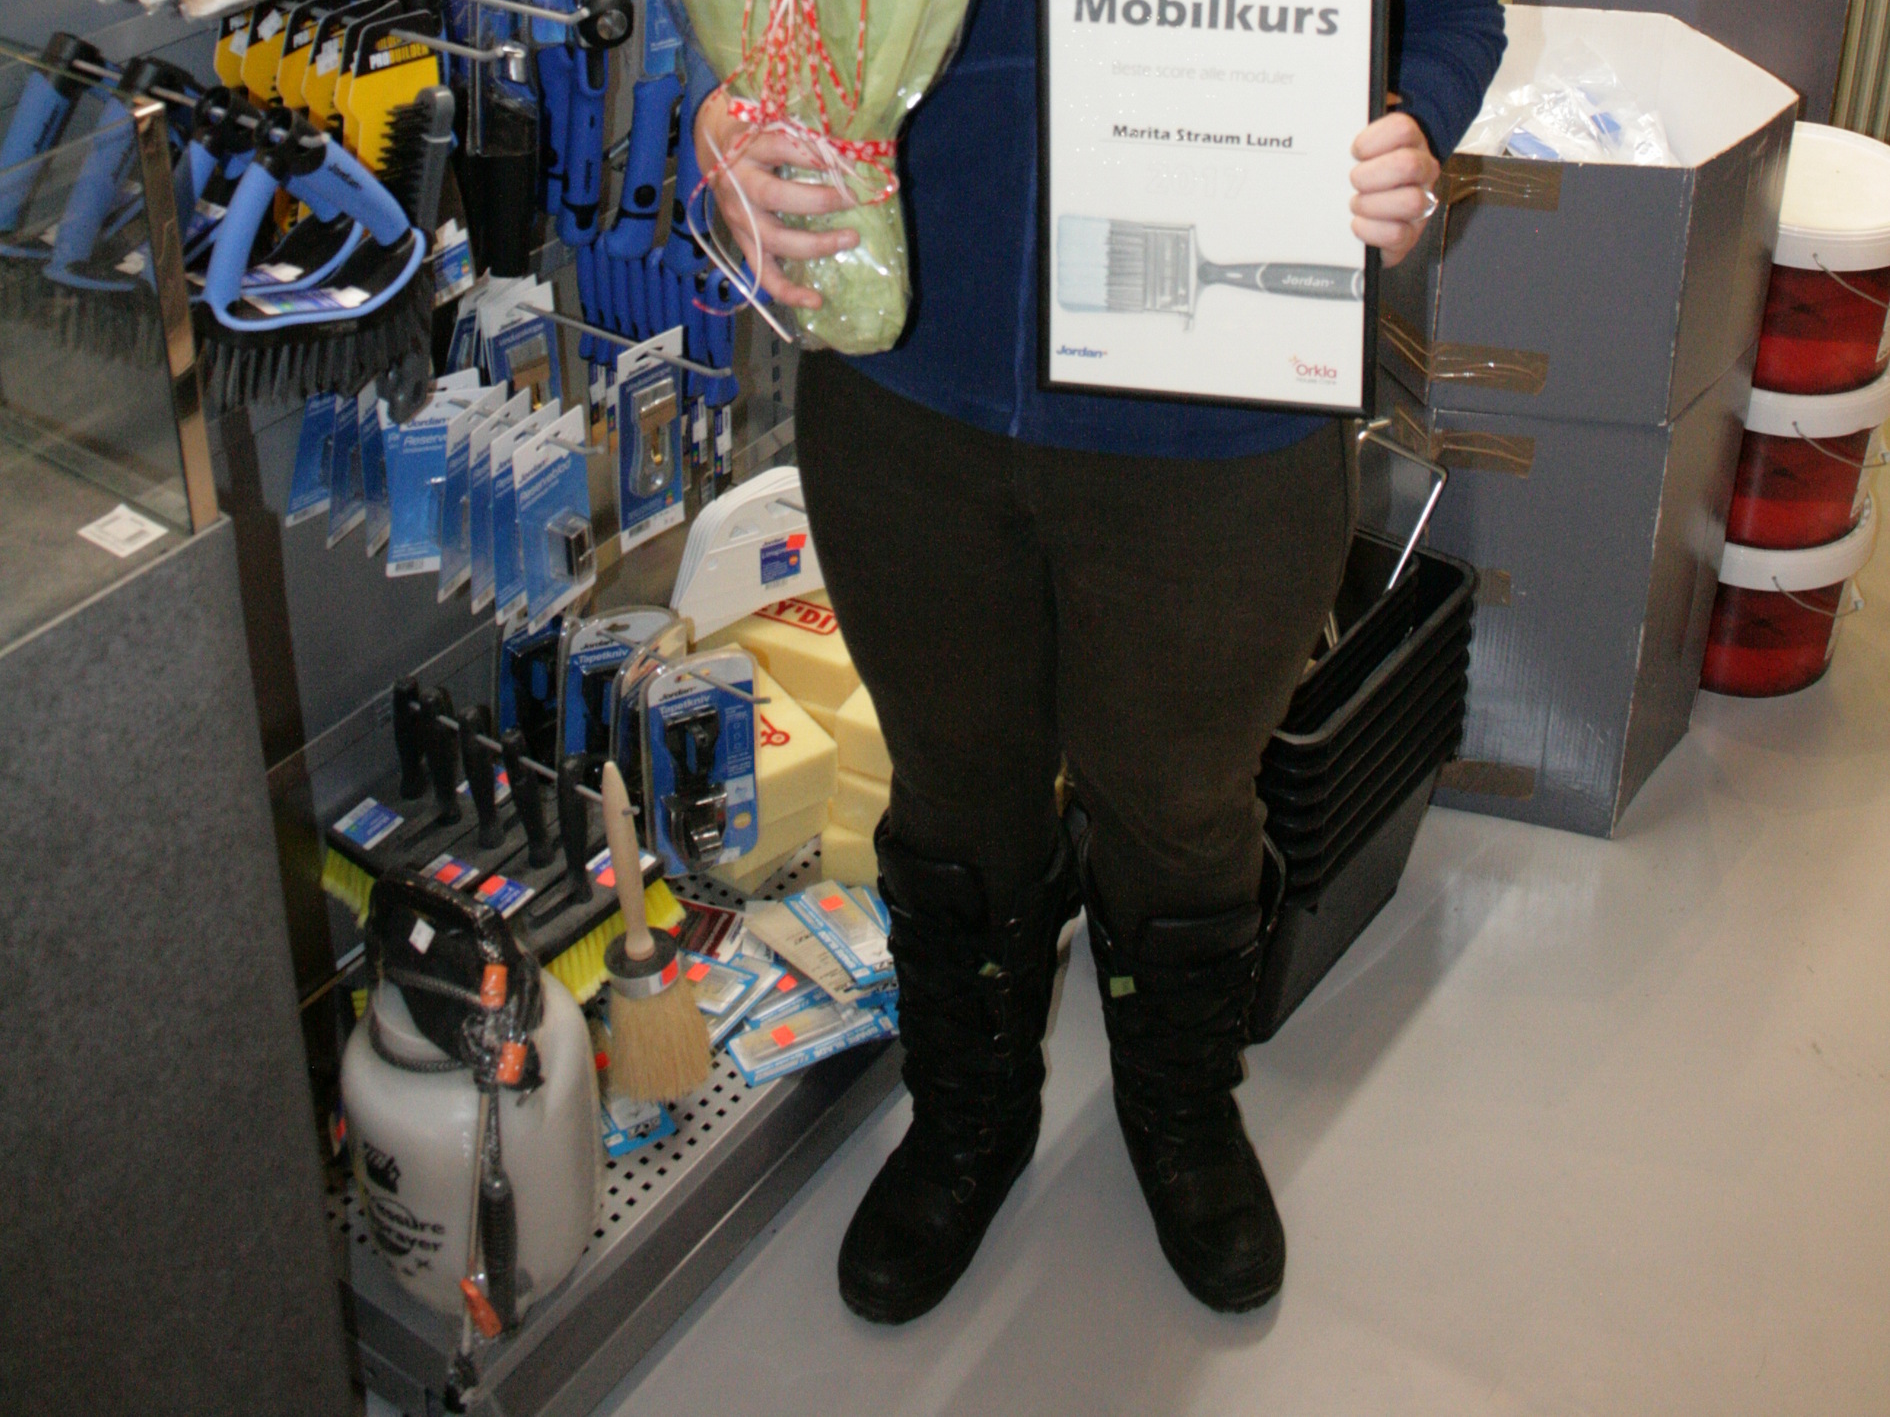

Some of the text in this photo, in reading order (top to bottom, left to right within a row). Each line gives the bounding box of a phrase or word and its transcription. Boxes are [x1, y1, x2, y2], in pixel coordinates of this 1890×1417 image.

[1176, 128, 1241, 145] Straum
[1246, 133, 1294, 149] Lund
[1281, 273, 1333, 288] Jordan
[1055, 344, 1106, 359] Jordan
[1295, 362, 1338, 379] Orkla
[577, 648, 629, 664] Tapetkniv
[658, 694, 713, 714] Tapetkniv
